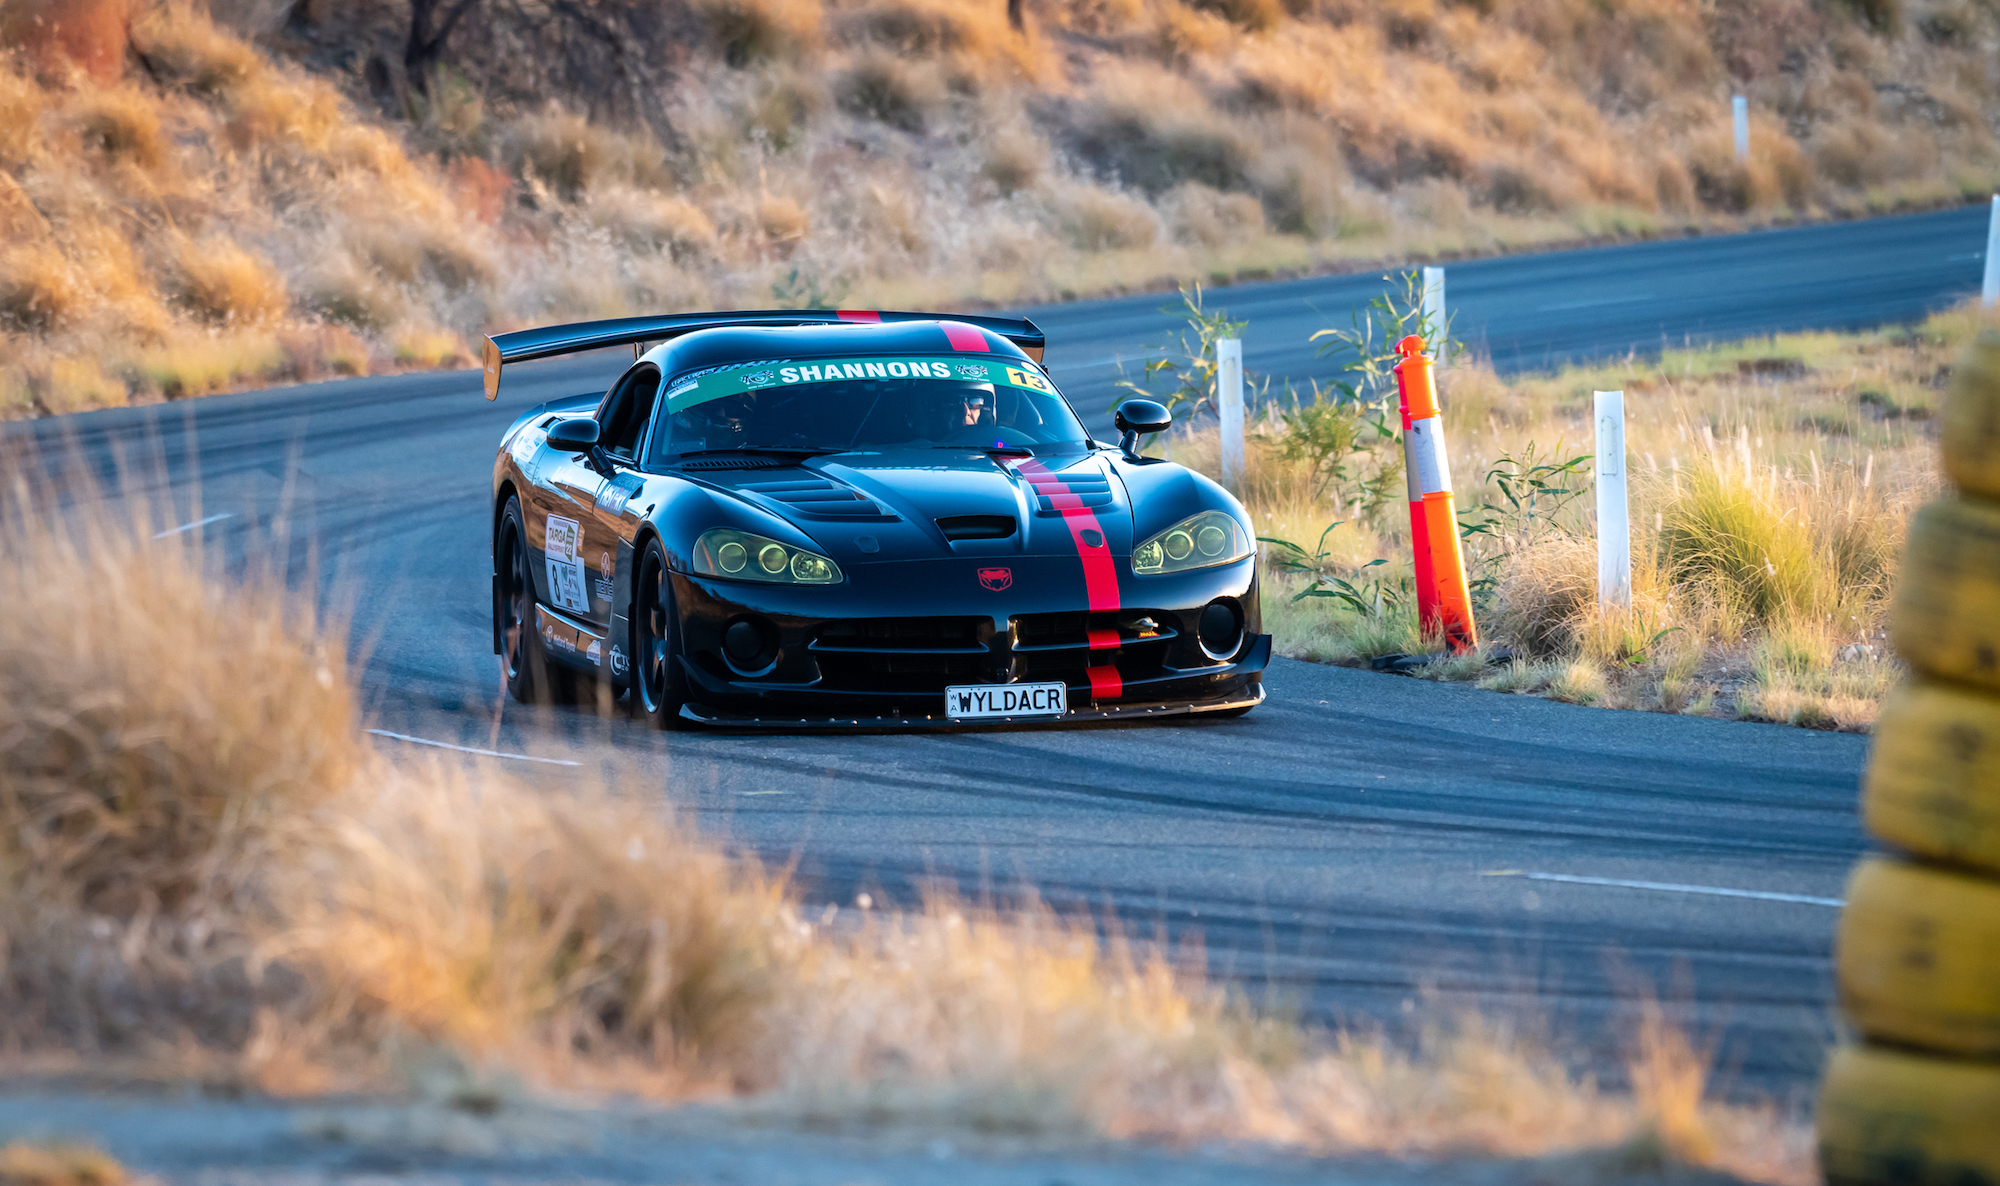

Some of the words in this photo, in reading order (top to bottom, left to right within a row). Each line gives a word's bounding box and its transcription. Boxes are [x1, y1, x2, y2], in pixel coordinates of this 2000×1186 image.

[780, 361, 951, 383] SHANNONS
[1013, 371, 1047, 390] 13
[548, 527, 566, 544] TARGA
[552, 564, 561, 602] 8
[958, 689, 1061, 713] WYLDACR
